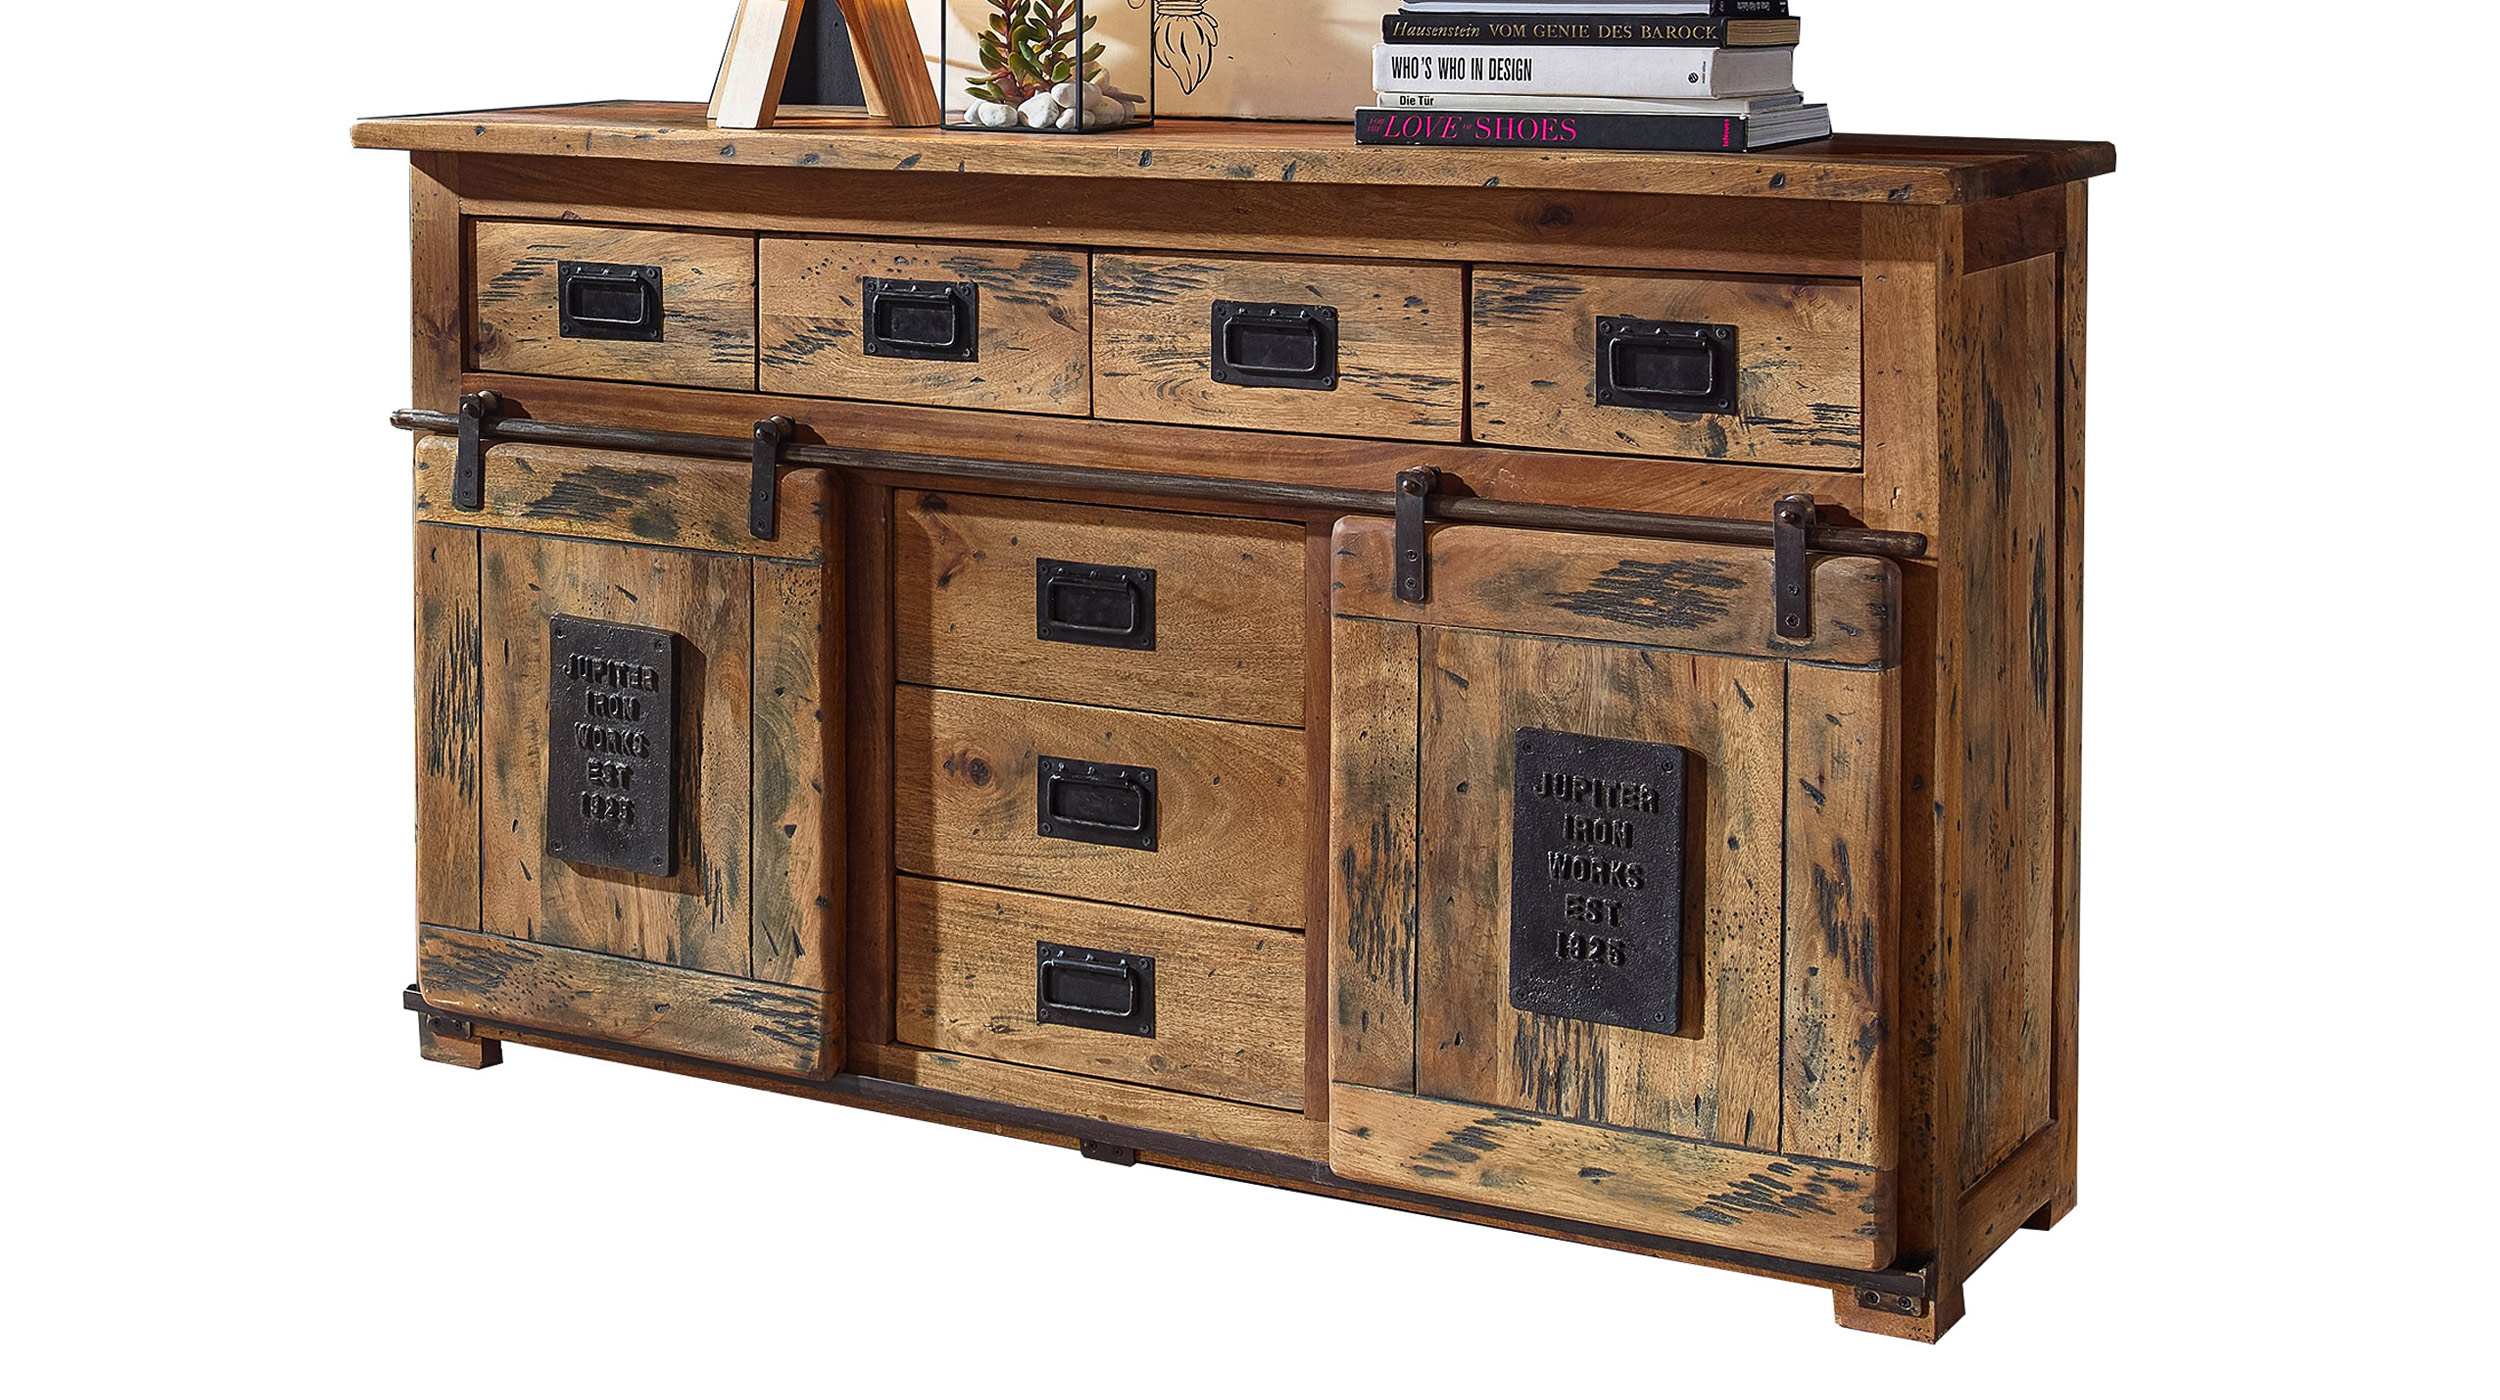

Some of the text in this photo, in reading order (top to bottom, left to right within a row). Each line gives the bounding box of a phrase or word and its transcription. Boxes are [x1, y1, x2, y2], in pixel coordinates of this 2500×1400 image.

[1392, 21, 1719, 40] Hausenstein VOM GENIE DES BAROCK
[1391, 56, 1532, 81] WHO'S WHO IN DESIGN
[1399, 95, 1435, 106] Die Tür
[1384, 115, 1463, 139] LOVE
[1475, 116, 1577, 141] SHOES
[562, 653, 660, 693] JUPITER
[585, 686, 641, 722] IRON
[574, 722, 650, 759] WORKS
[587, 757, 634, 791] EST
[1533, 771, 1660, 813] JUPITER
[1562, 813, 1634, 849] IRON
[1547, 851, 1645, 890] WORKS
[1564, 893, 1622, 928] EST
